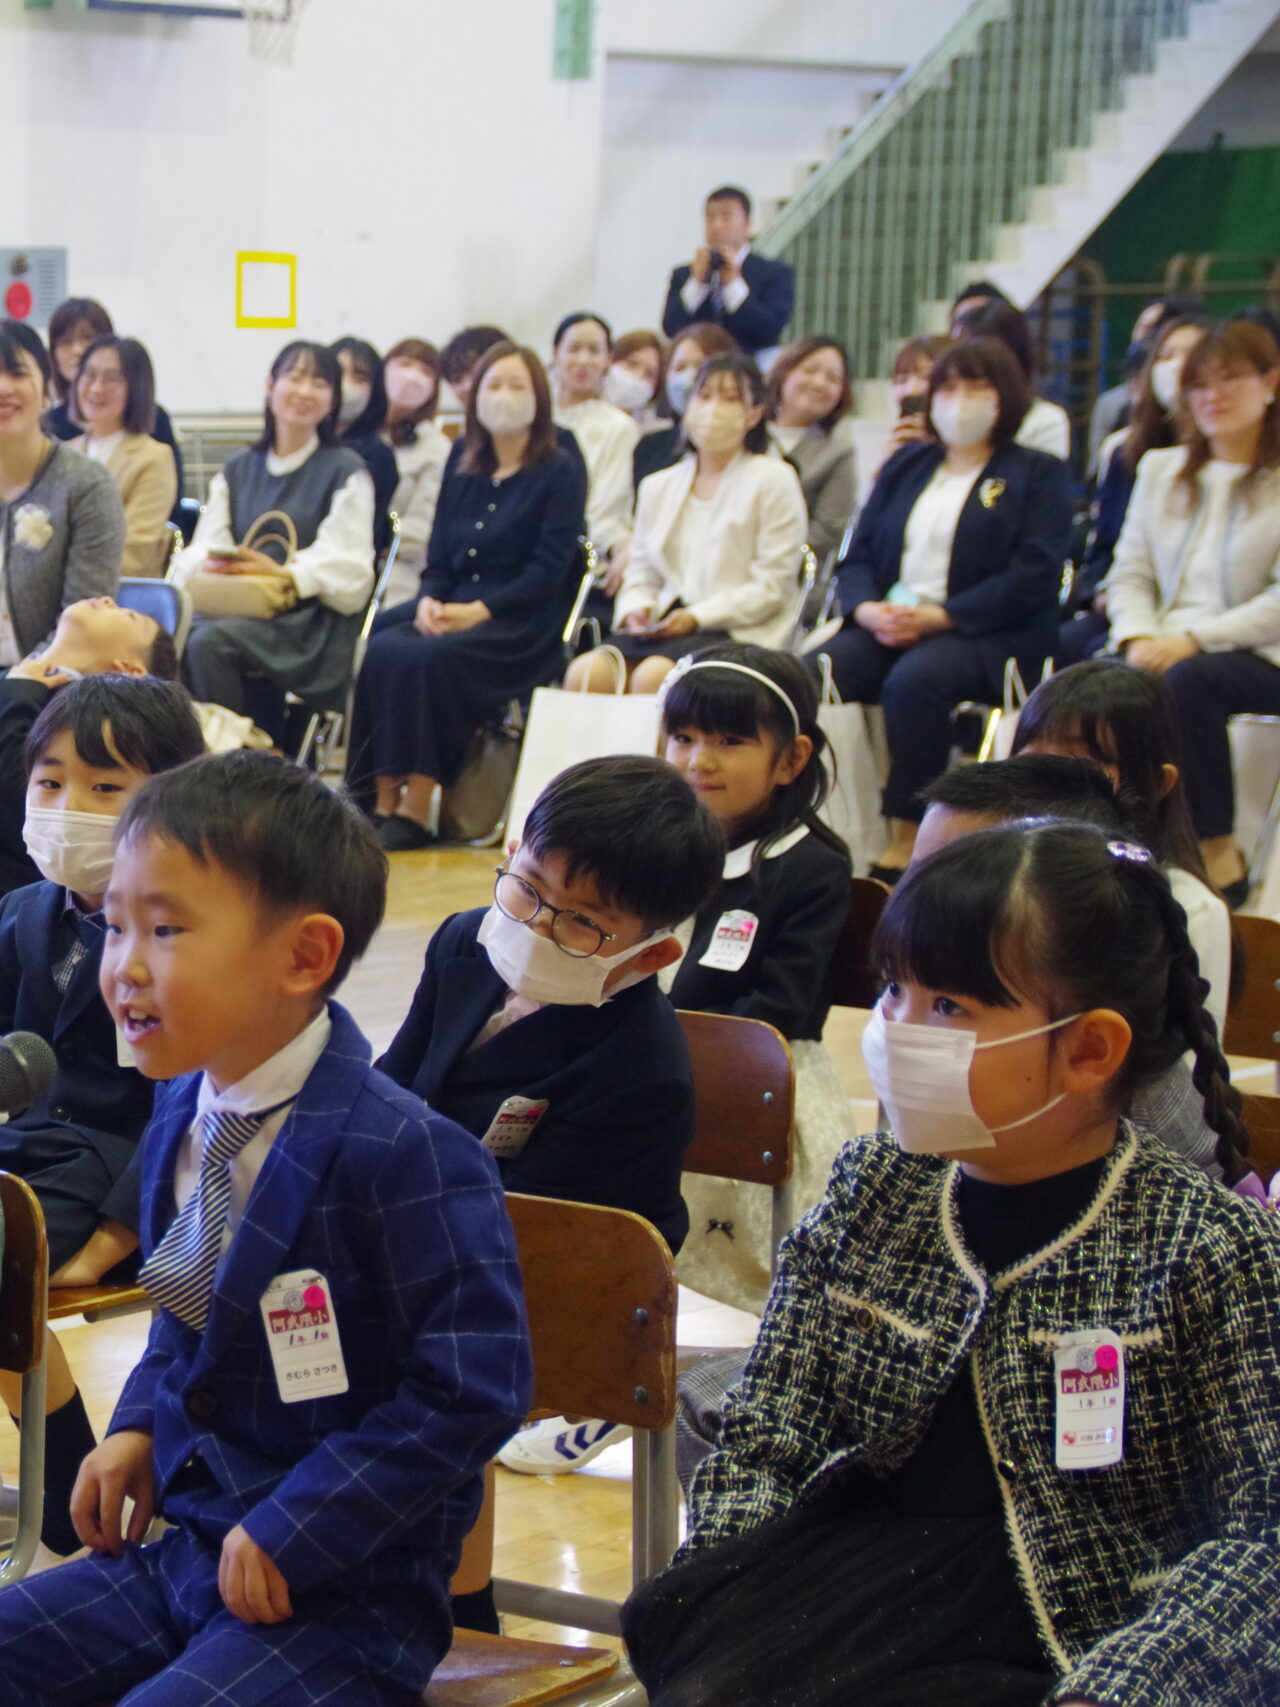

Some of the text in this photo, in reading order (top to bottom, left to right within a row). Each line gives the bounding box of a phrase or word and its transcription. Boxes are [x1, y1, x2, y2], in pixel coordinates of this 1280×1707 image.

[273, 1310, 328, 1332] 阿武隈小
[285, 1364, 337, 1381] きむら さつき
[1063, 1373, 1119, 1393] 阿武隈小
